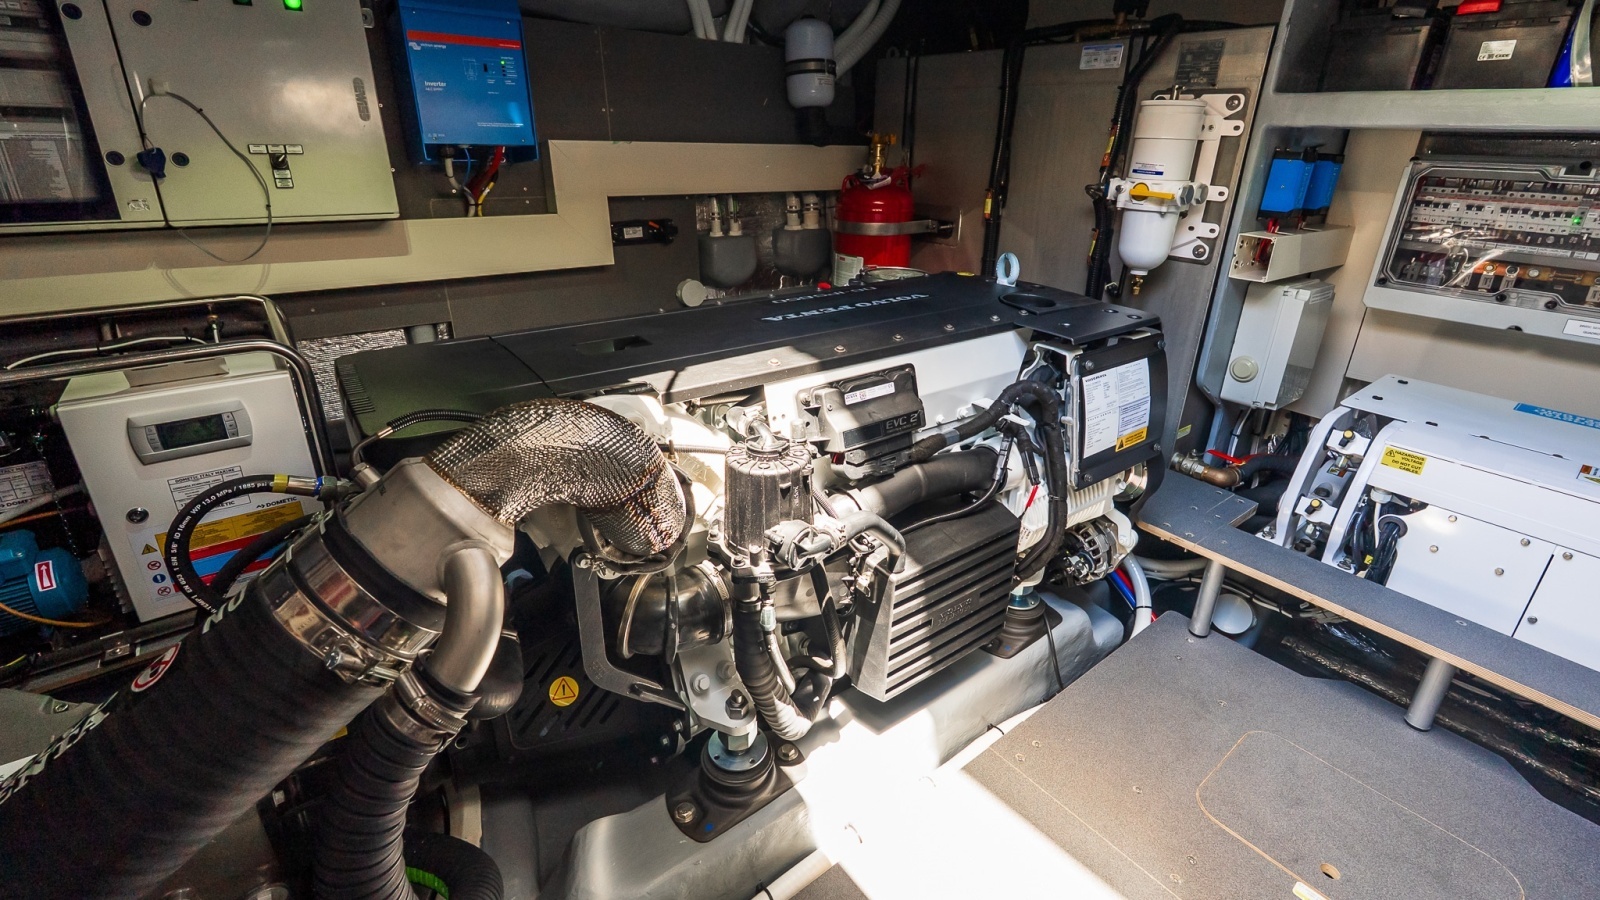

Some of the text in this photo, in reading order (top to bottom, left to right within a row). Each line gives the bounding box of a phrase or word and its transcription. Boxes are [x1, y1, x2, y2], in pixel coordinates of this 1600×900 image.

[761, 293, 929, 322] VOLVO PENTA
[885, 416, 907, 430] EVC
[910, 413, 918, 423] 2
[1395, 451, 1424, 461] HAZARDOUS
[1401, 457, 1423, 465] VOLTAGE
[216, 489, 233, 498] MPa
[201, 495, 217, 506] 13.0
[266, 496, 298, 508] DOMETIC
[190, 504, 202, 515] WP
[177, 515, 192, 532] 16mm
[173, 532, 181, 540] ID
[171, 556, 178, 566] SN
[183, 585, 193, 594] EN
